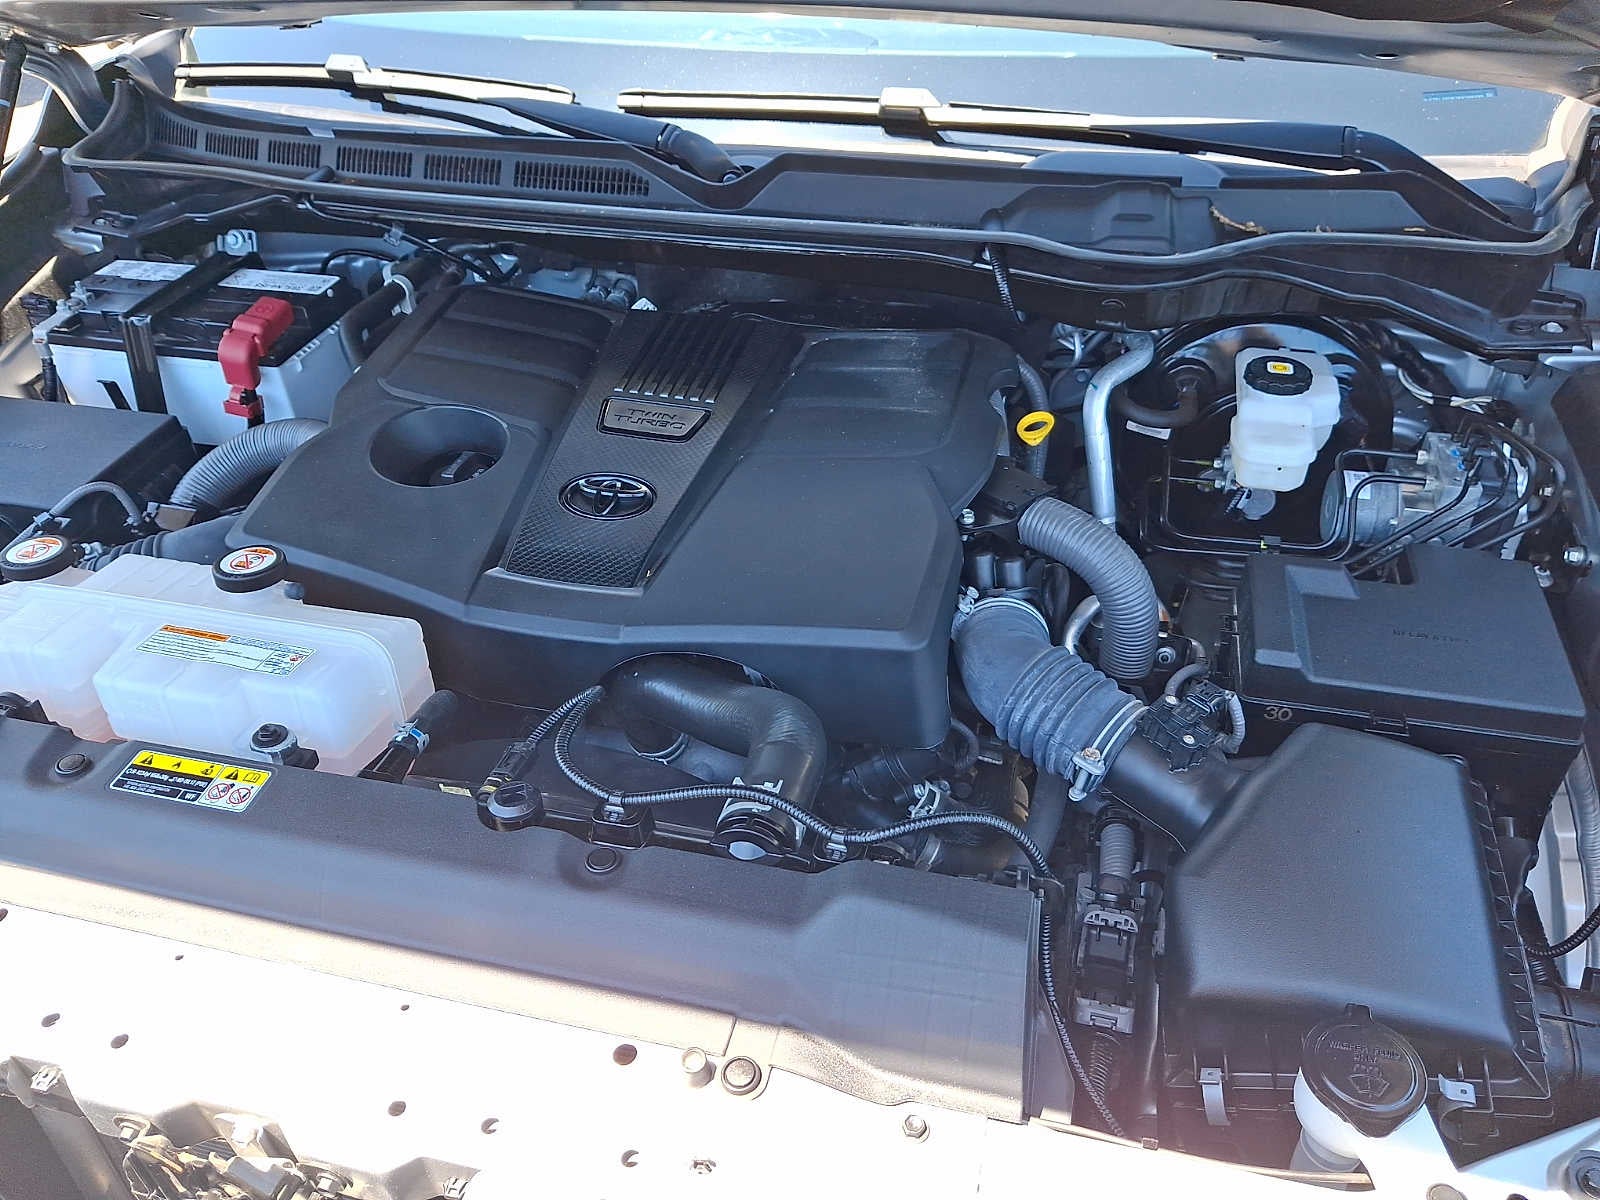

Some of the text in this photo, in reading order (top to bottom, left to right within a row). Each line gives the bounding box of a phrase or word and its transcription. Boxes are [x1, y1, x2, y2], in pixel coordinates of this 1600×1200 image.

[614, 414, 686, 429] TURBO
[627, 408, 677, 420] TWIN
[1264, 706, 1293, 722] 30
